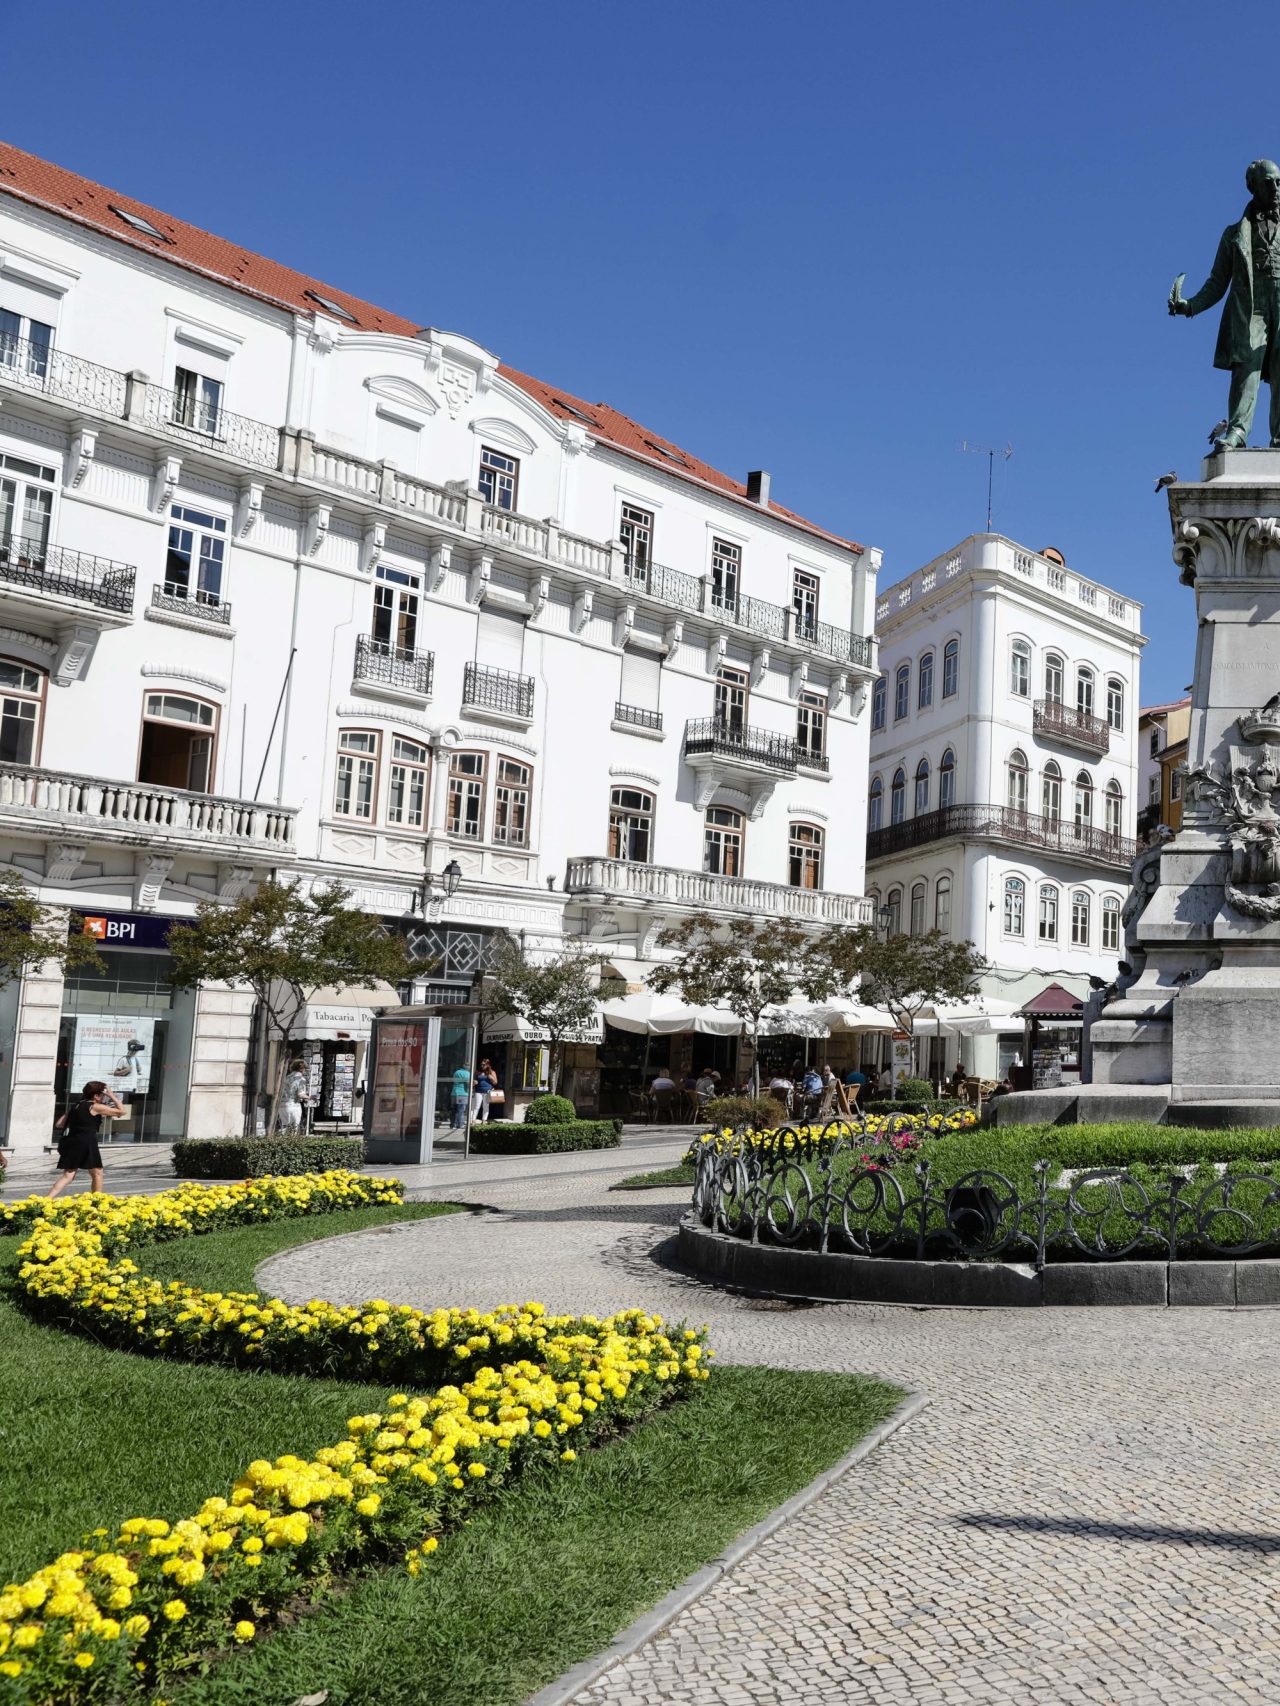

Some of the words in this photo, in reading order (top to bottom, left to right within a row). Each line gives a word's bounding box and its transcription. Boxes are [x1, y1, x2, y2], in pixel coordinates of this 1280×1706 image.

[106, 921, 136, 939] BPI
[313, 1011, 355, 1022] Tabacaria
[524, 1031, 543, 1039] OURO
